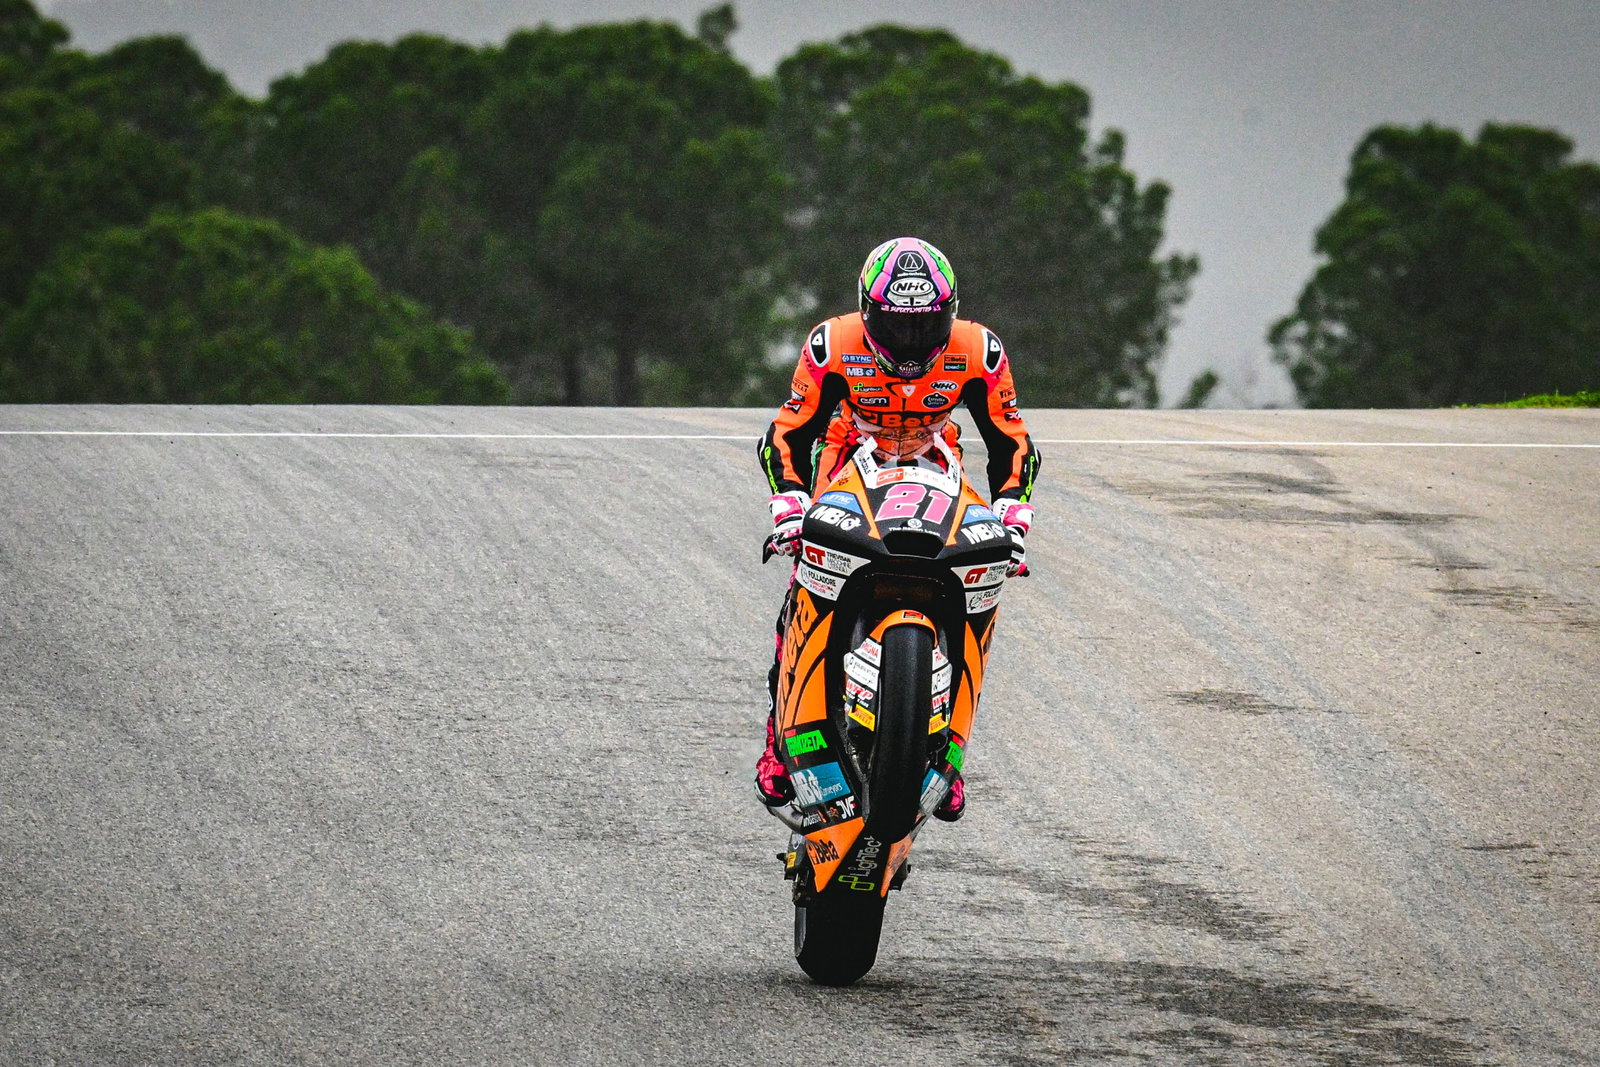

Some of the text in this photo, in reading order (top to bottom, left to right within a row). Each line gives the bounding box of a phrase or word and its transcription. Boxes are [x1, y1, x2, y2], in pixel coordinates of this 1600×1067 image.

[875, 483, 953, 525] 21
[805, 545, 826, 567] GT
[808, 570, 837, 588] FOLLADORE
[963, 567, 989, 585] GT
